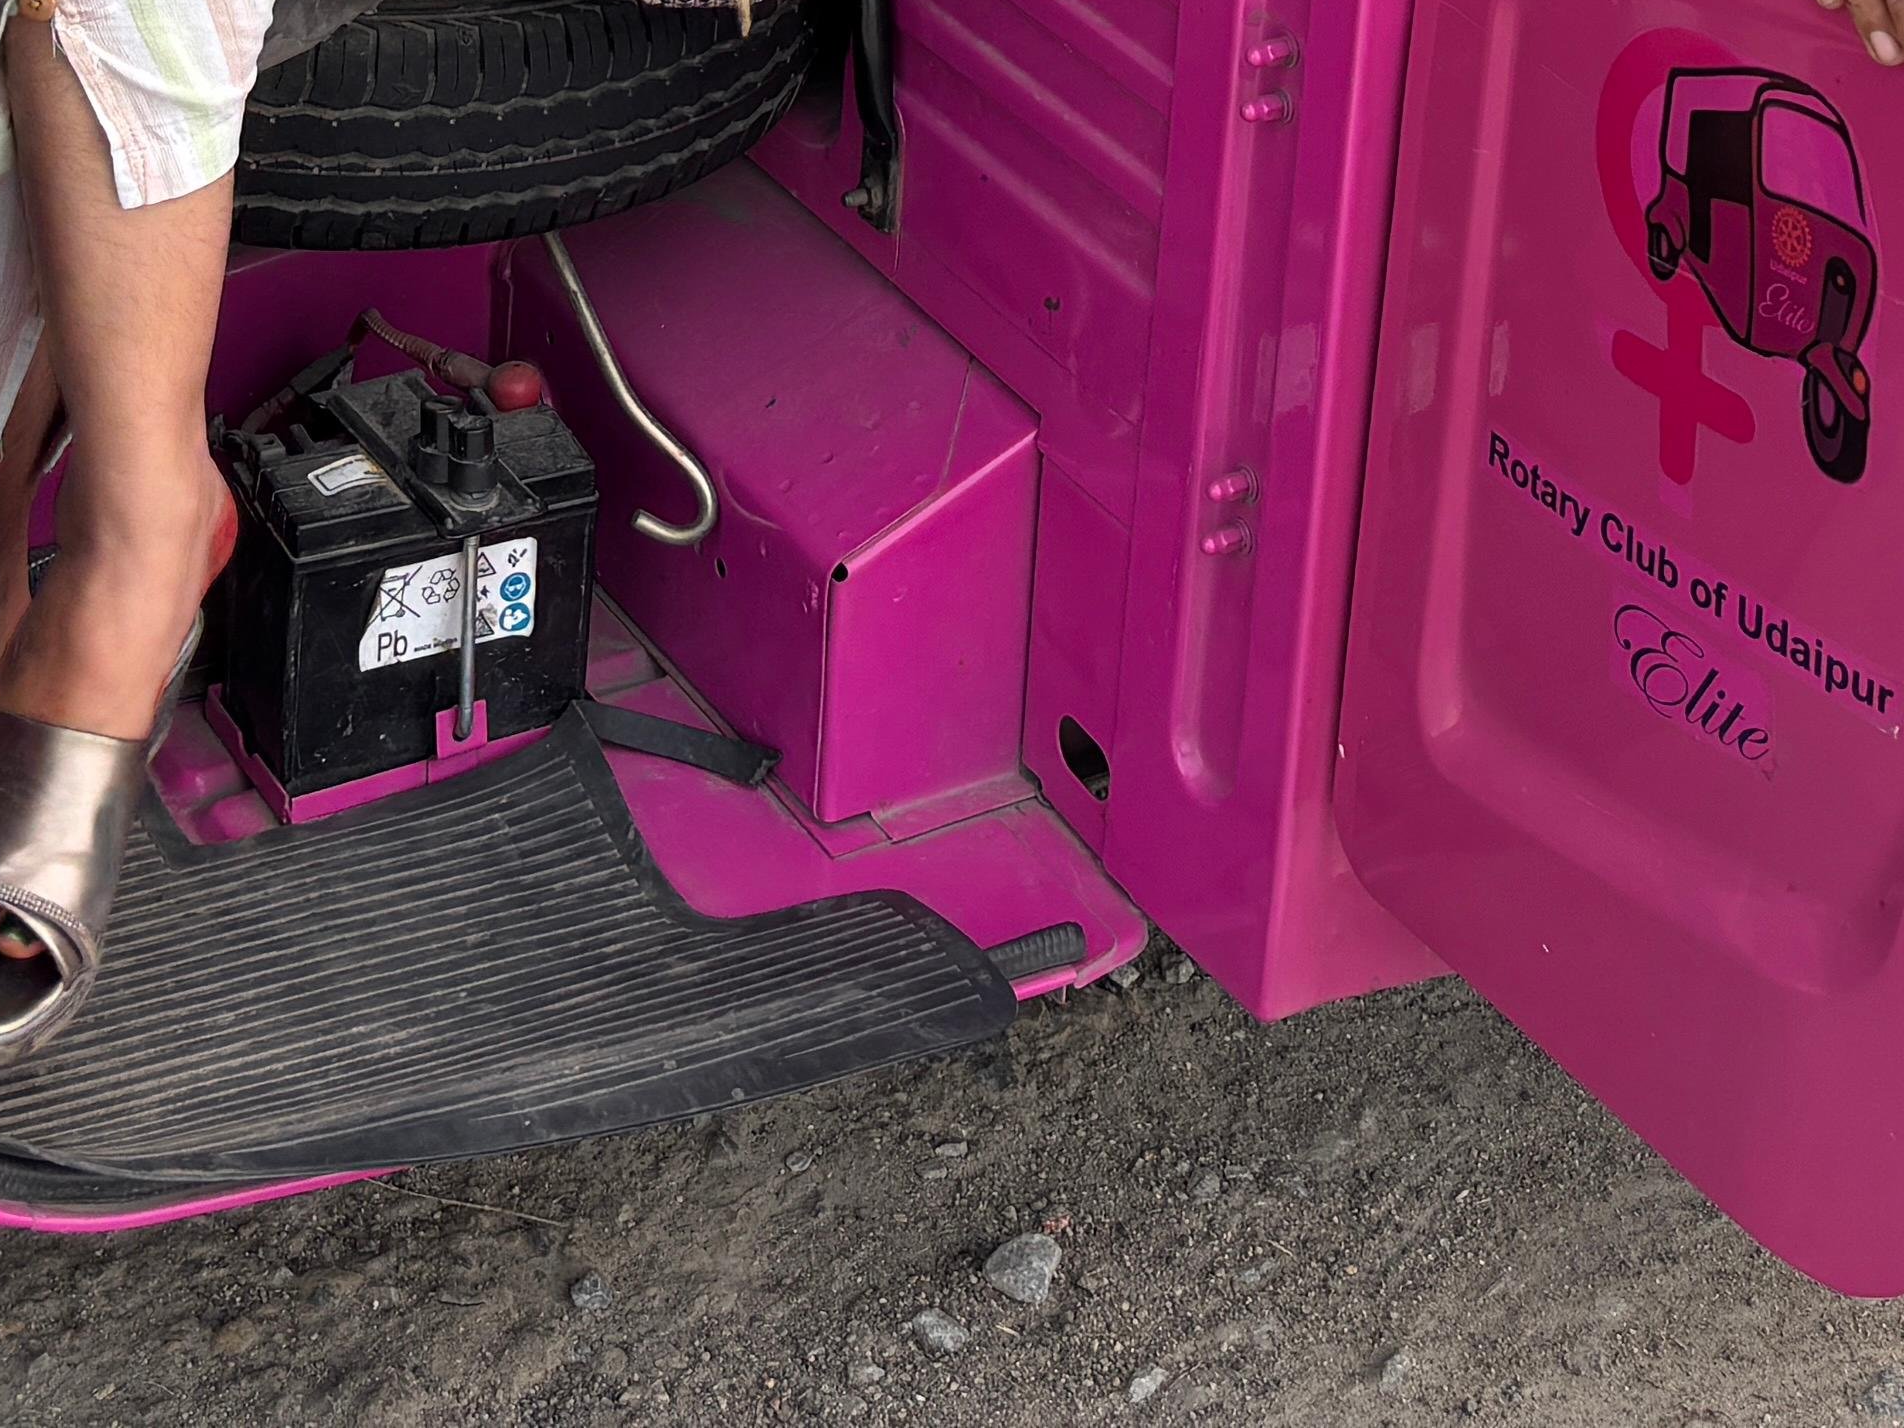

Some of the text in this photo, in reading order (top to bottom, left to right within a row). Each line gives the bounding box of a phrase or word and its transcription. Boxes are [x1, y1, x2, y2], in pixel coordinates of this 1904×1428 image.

[375, 630, 410, 665] Pb
[1486, 430, 1896, 716] Rotary Club of Udaipur
[1611, 602, 1775, 765] Elite
